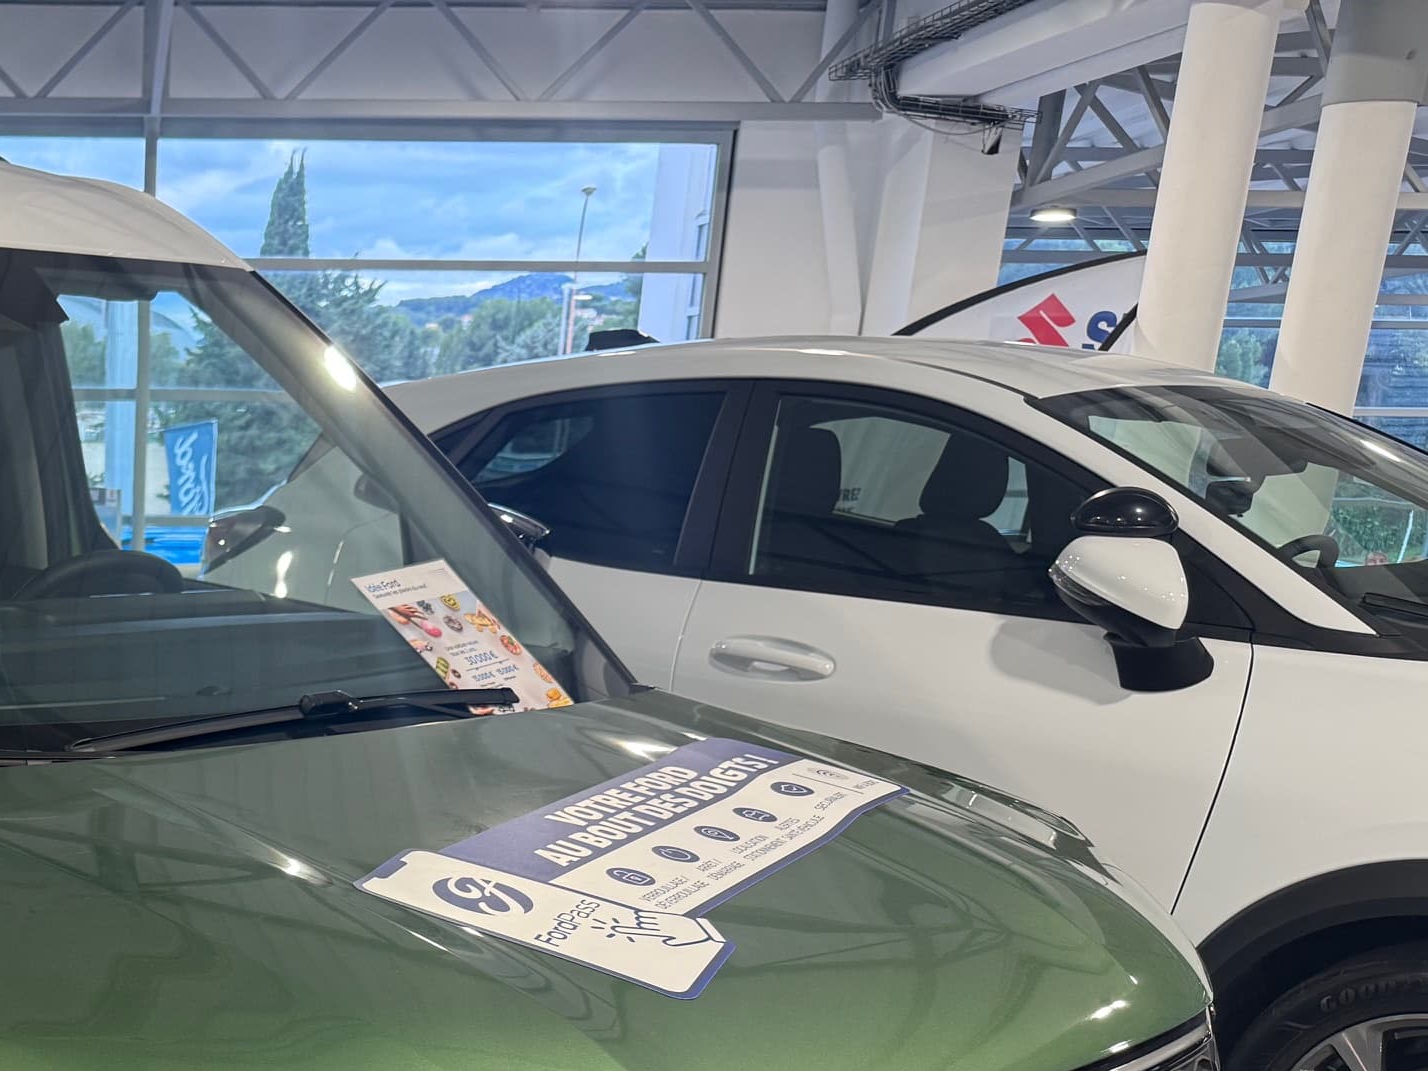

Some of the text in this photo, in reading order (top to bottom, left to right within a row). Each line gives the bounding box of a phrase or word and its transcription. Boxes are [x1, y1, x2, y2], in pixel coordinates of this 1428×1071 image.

[534, 840, 593, 867] AU
[570, 812, 657, 849] BOUT
[632, 793, 699, 820] DES
[675, 757, 769, 800] DOIGTS
[543, 766, 699, 827] VOTRE FORD
[534, 899, 601, 947] FordPass
